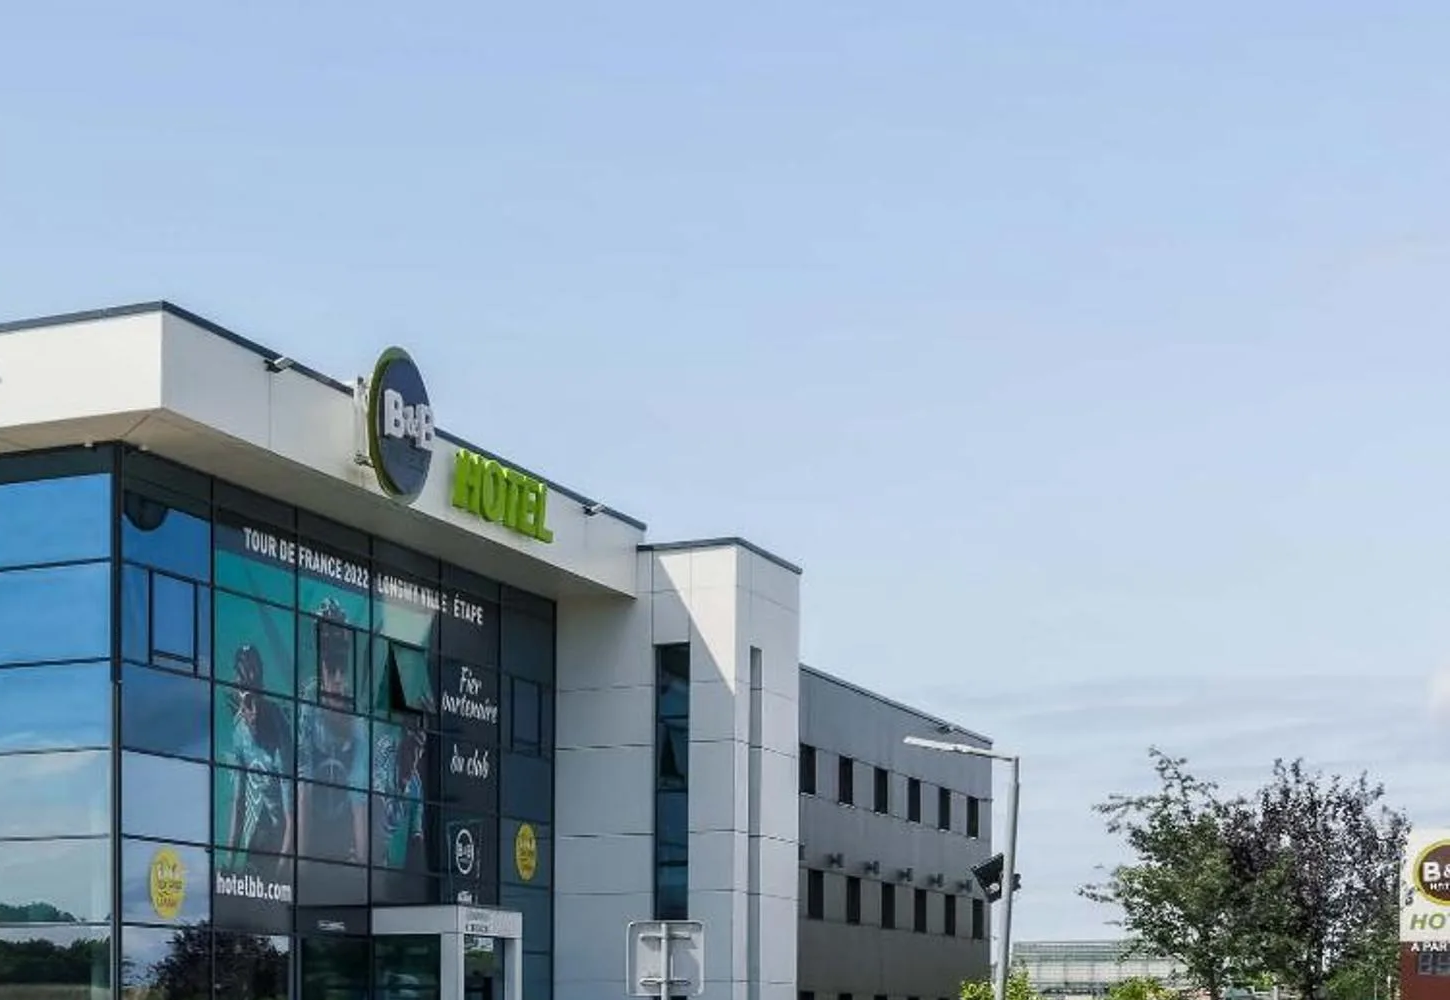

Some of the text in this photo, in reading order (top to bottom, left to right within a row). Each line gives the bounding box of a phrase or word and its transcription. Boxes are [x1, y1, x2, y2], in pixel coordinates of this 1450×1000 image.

[384, 388, 435, 450] B&B
[452, 447, 554, 544] HOTEL
[242, 527, 278, 559] TOUR
[279, 540, 296, 565] DE
[298, 545, 343, 580] FRANCE
[343, 563, 370, 590] 2022
[453, 591, 484, 626] ÉTAPE
[459, 666, 482, 695] Fier
[215, 870, 293, 903] hotelbb.com
[1410, 912, 1450, 931] HO
